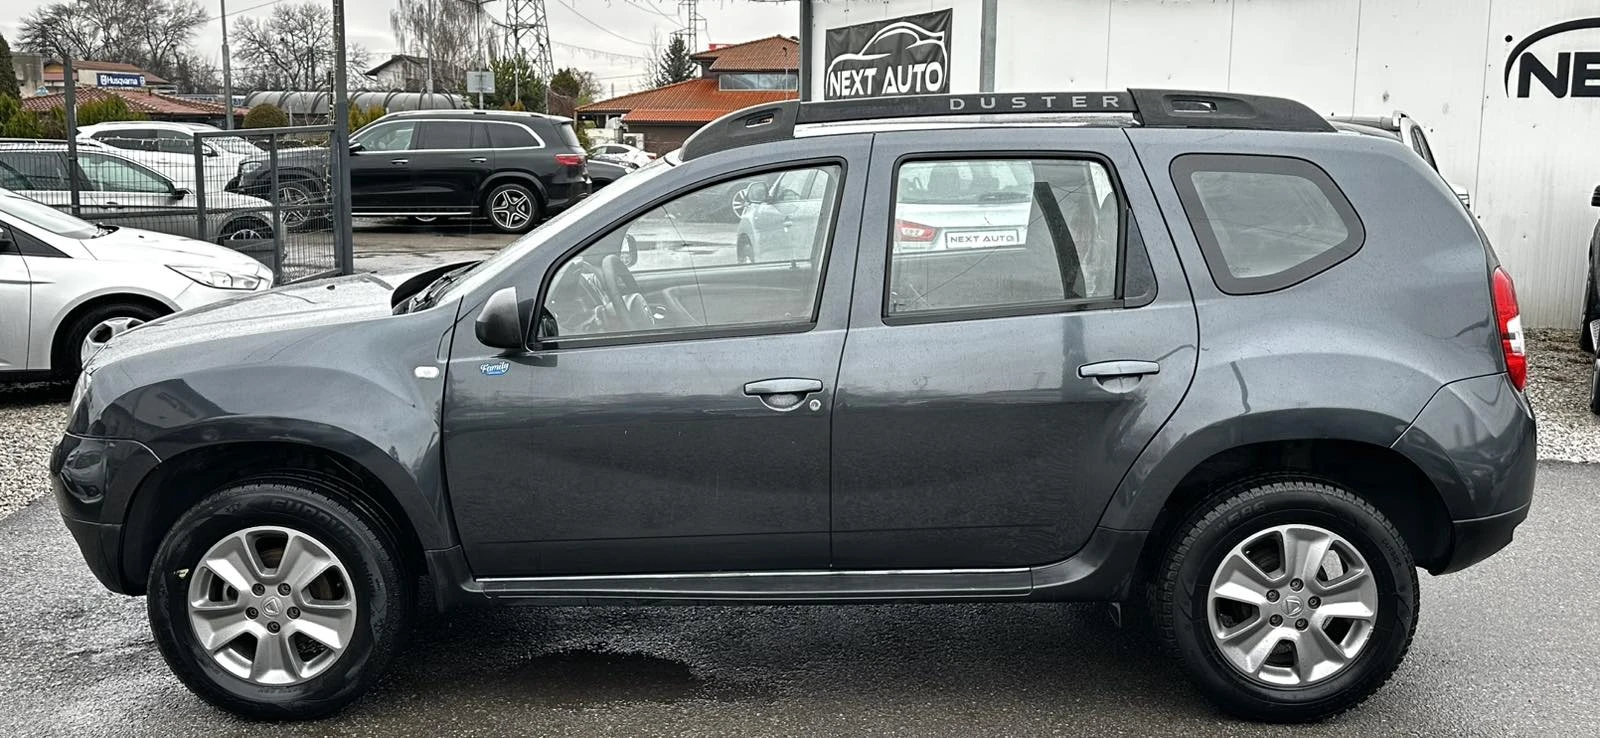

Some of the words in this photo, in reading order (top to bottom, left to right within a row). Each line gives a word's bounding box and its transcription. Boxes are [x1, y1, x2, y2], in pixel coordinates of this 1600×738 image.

[107, 75, 138, 86] Husqvarna
[829, 67, 878, 97] NEXT
[881, 61, 943, 94] AUTO
[950, 95, 1119, 110] DUSTER
[950, 235, 979, 243] NEXT
[982, 234, 1015, 242] AUTO
[480, 361, 509, 373] Family
